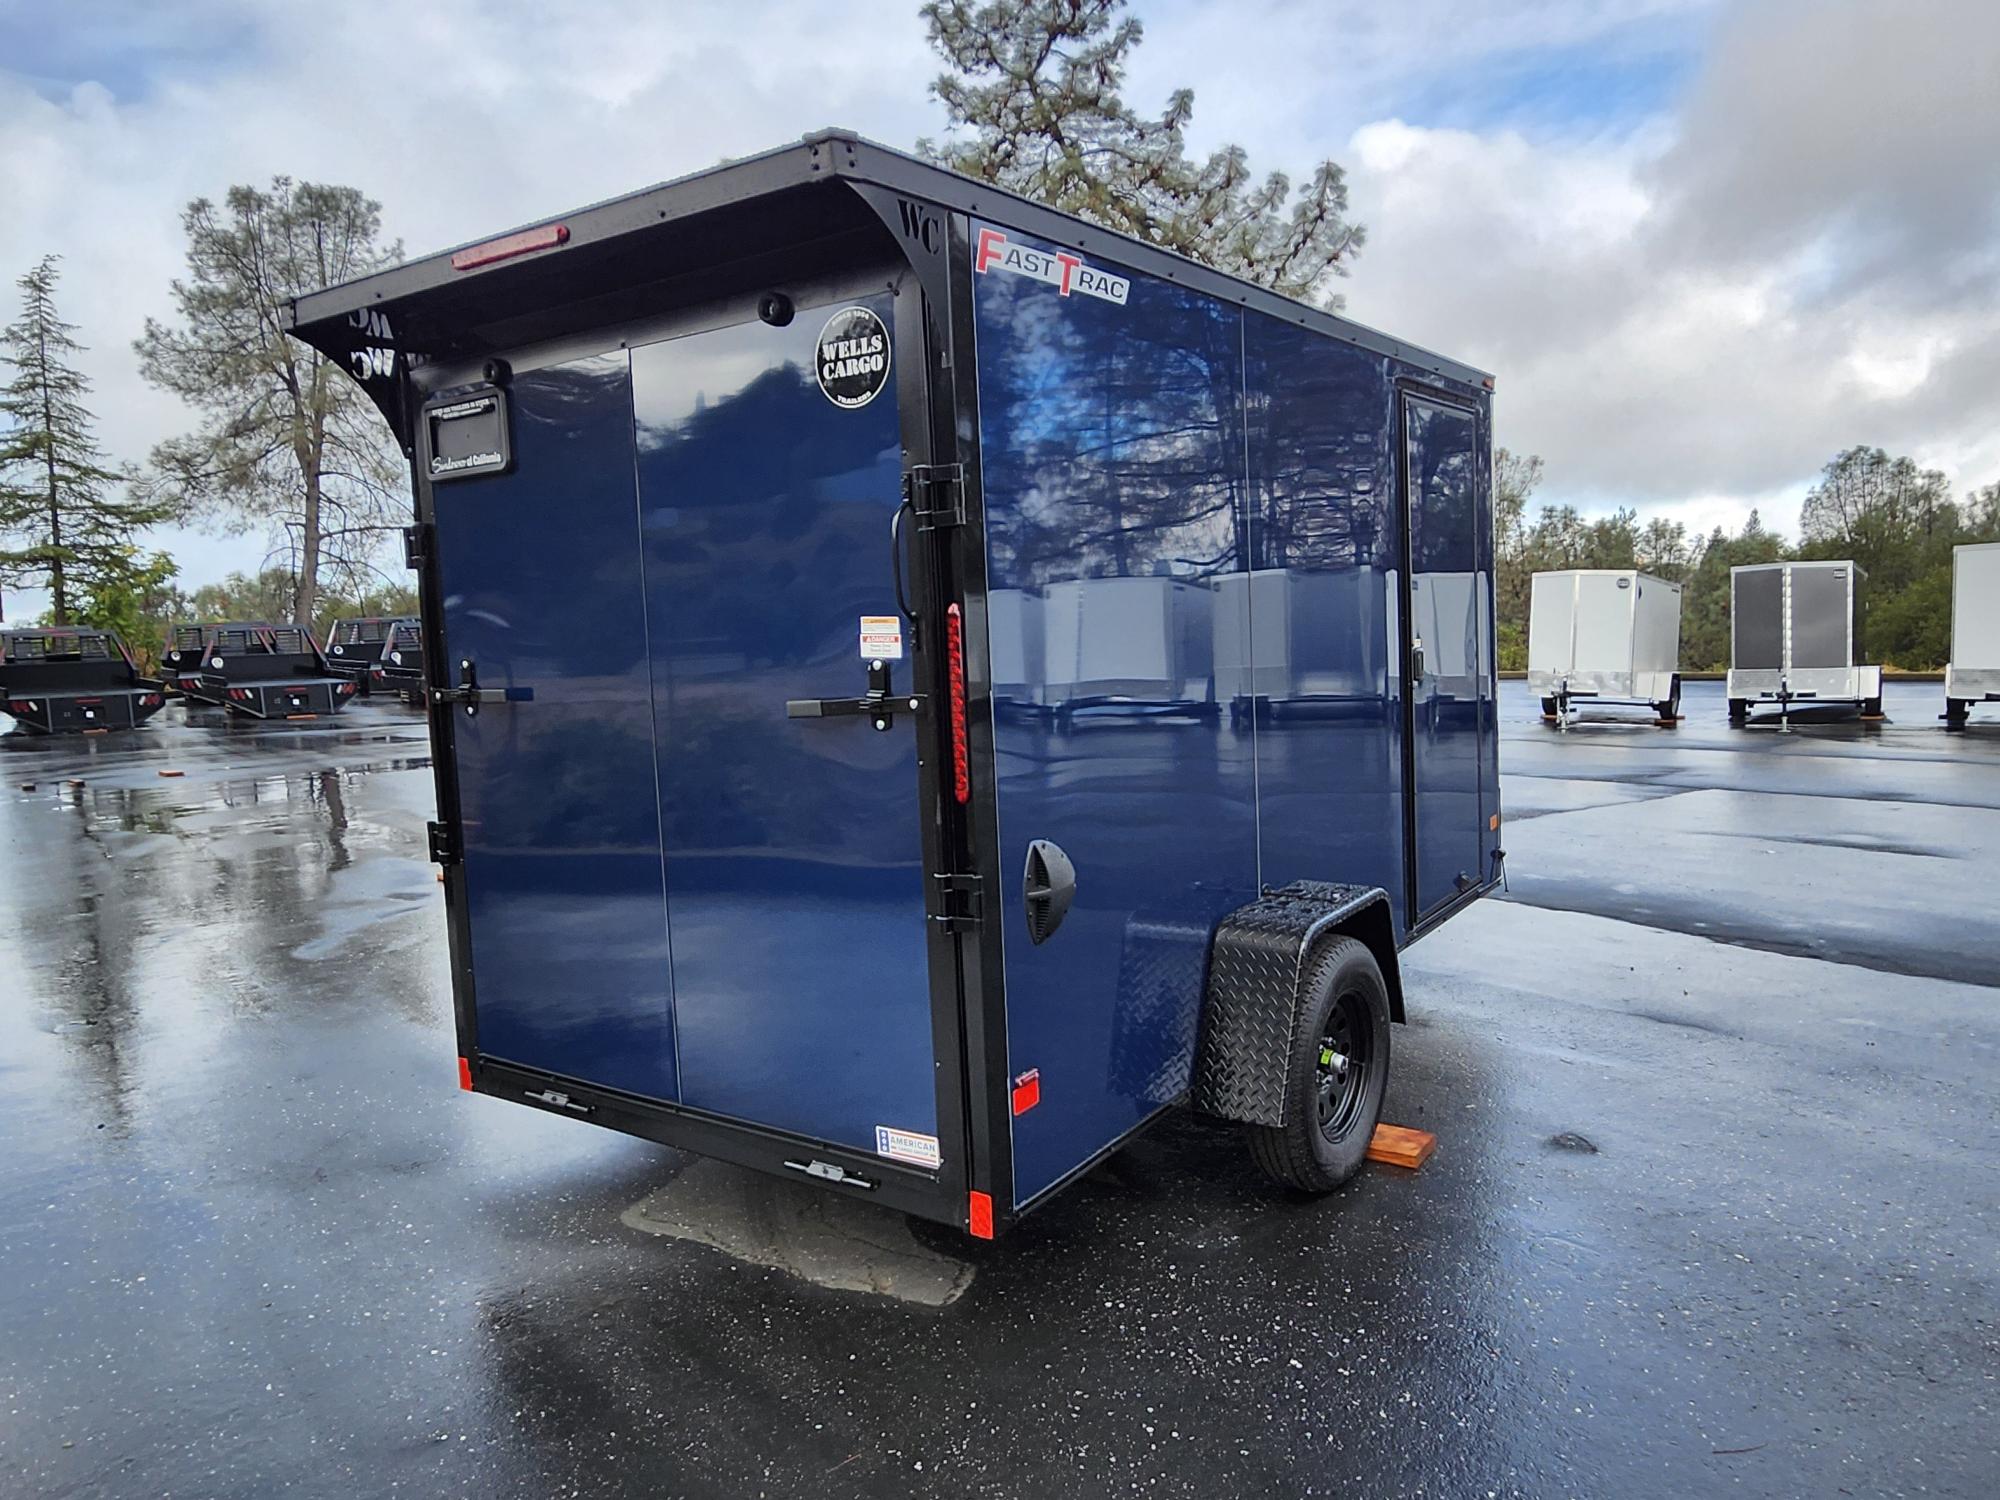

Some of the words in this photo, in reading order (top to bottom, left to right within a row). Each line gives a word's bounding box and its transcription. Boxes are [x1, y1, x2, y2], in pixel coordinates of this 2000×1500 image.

[896, 199, 940, 256] WC
[822, 334, 883, 361] WELLS
[822, 354, 884, 380] CARGO
[890, 1136, 936, 1152] AMERICAN
